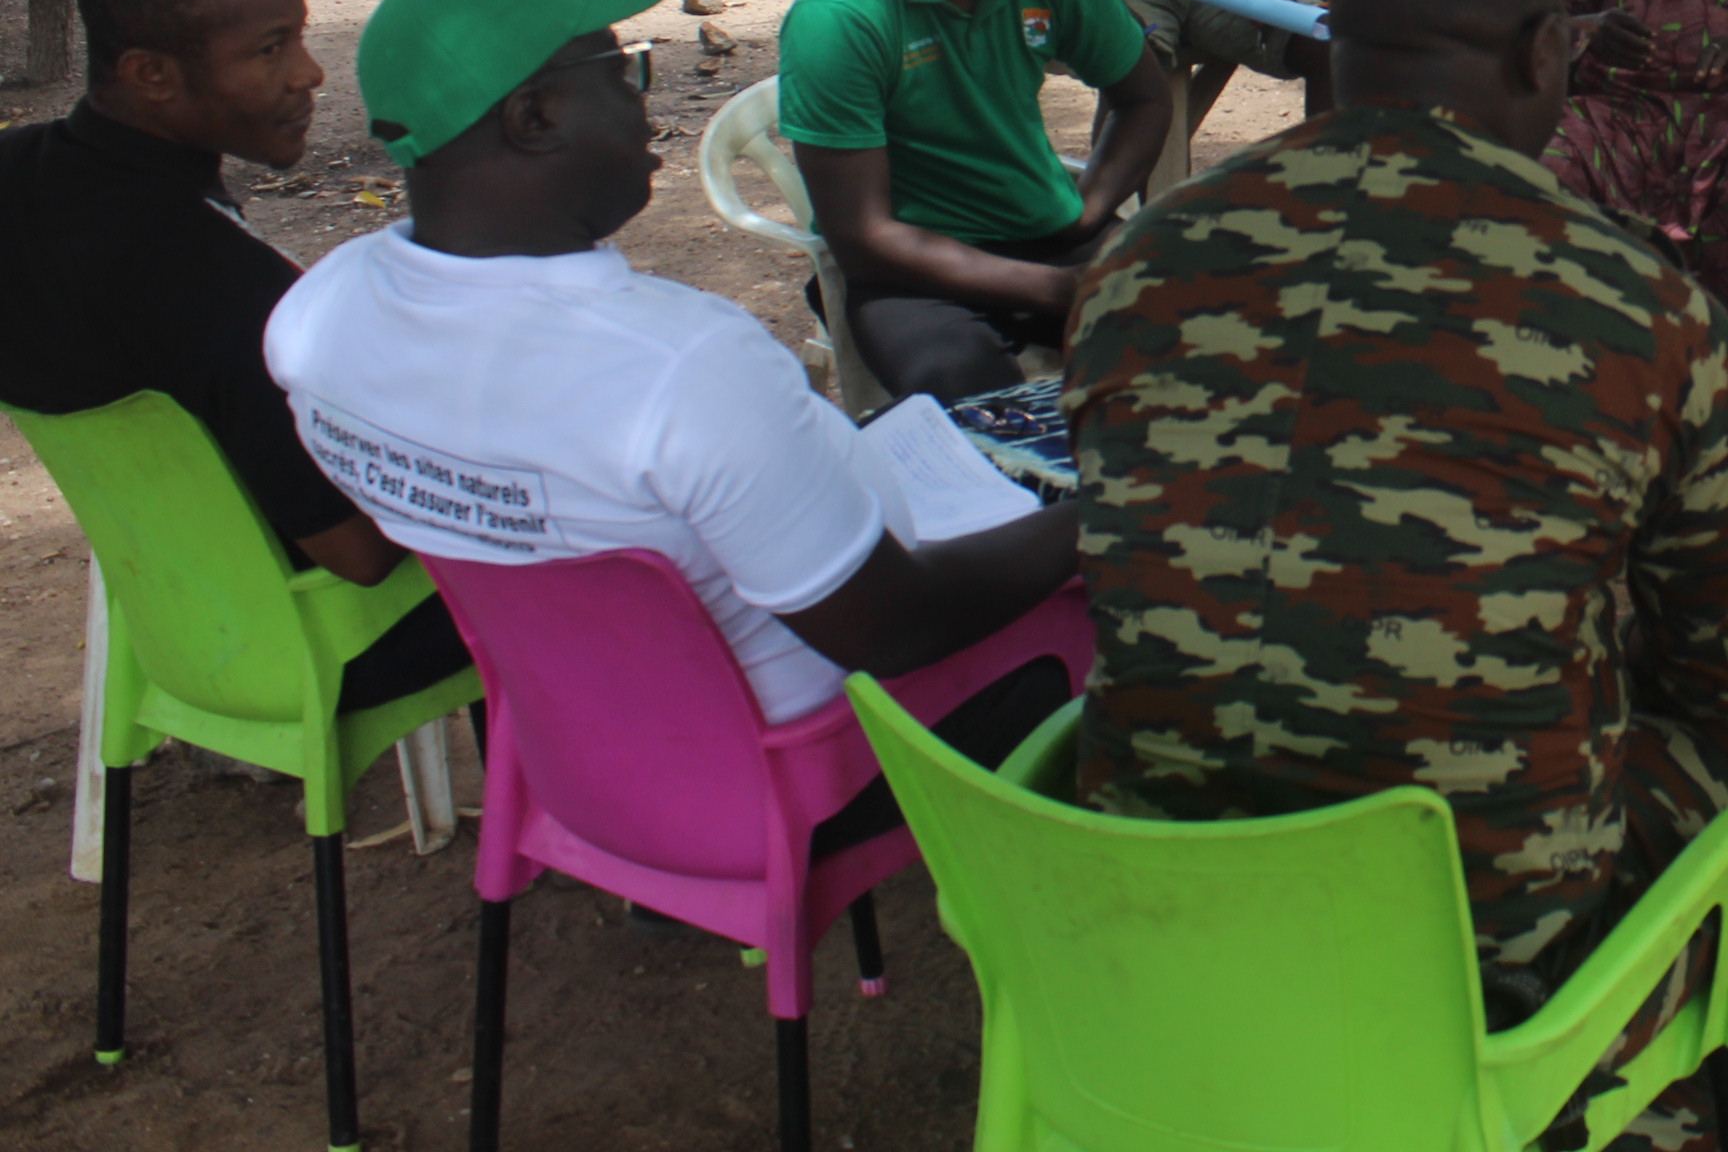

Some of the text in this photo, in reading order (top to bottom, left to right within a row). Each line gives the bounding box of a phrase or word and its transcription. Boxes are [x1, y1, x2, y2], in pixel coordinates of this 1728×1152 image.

[365, 461, 406, 499] C'est
[408, 485, 471, 522] assurer
[384, 443, 411, 470] les
[414, 455, 455, 486] sites
[458, 473, 531, 508] naturels
